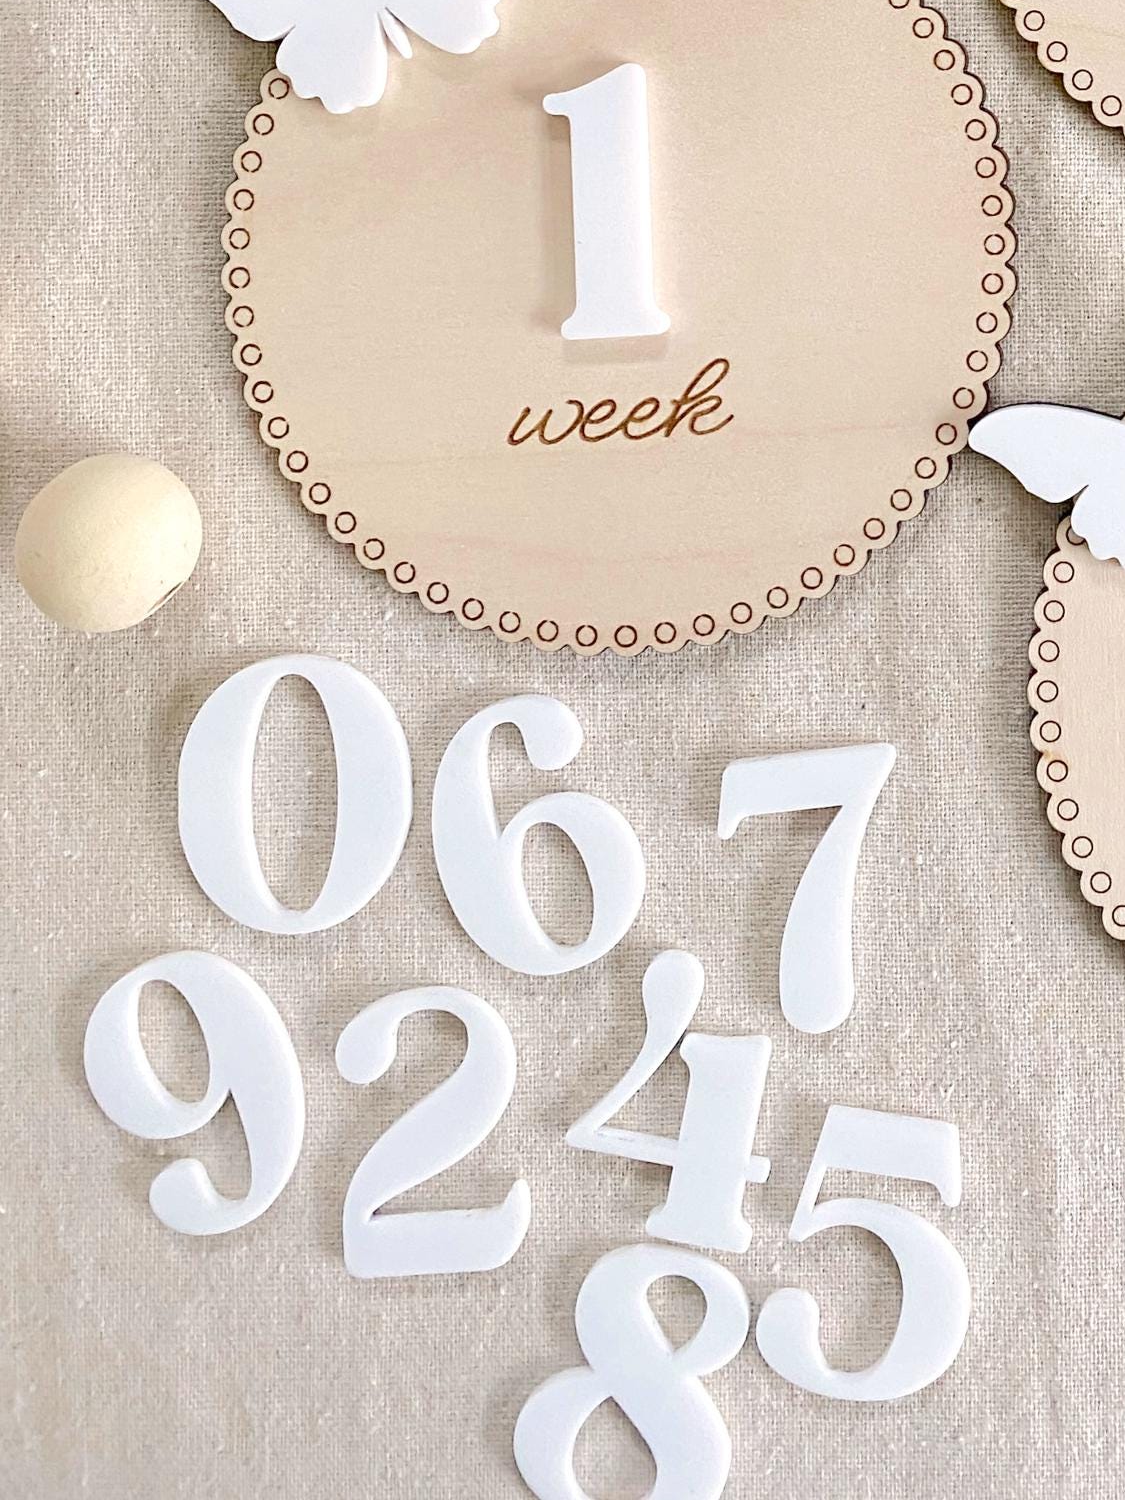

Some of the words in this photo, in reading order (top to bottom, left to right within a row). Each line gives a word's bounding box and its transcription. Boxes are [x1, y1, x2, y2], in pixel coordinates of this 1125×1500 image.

[542, 63, 671, 340] 1
[507, 358, 734, 446] week
[432, 693, 647, 976] 6
[717, 742, 897, 1034] 7
[83, 950, 306, 1235] 9
[335, 985, 532, 1279] 2
[565, 949, 774, 1253] 4
[513, 1244, 750, 1500] 8
[755, 1104, 972, 1401] 5
